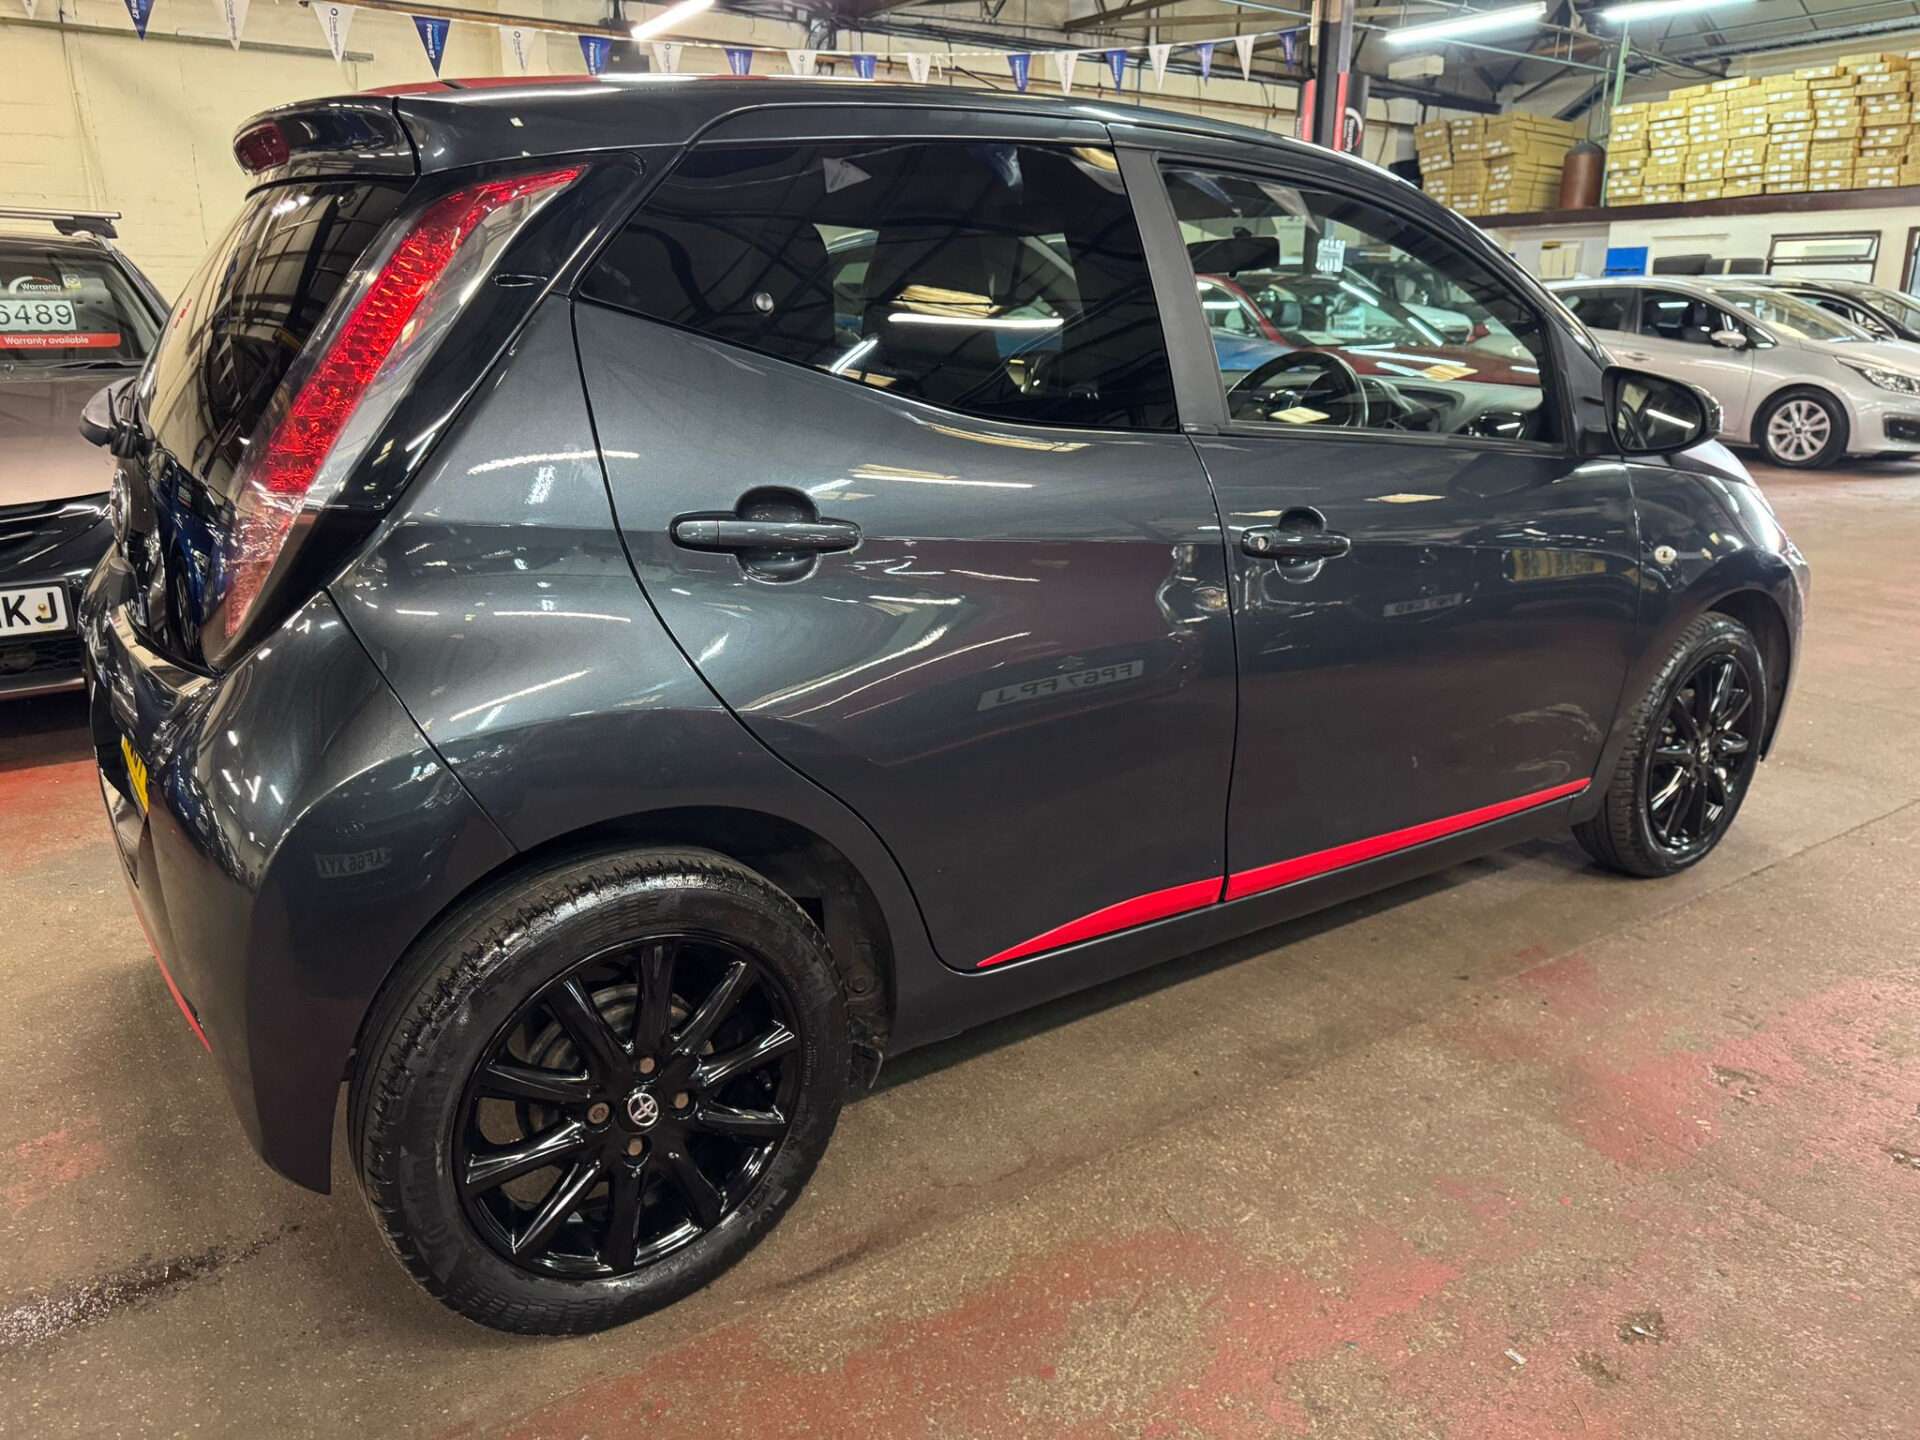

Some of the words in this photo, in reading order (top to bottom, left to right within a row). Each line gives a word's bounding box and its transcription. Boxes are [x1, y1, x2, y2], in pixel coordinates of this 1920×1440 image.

[428, 49, 436, 59] it?
[21, 283, 61, 292] Warranty
[5, 336, 47, 345] Warranty
[48, 336, 89, 344] available
